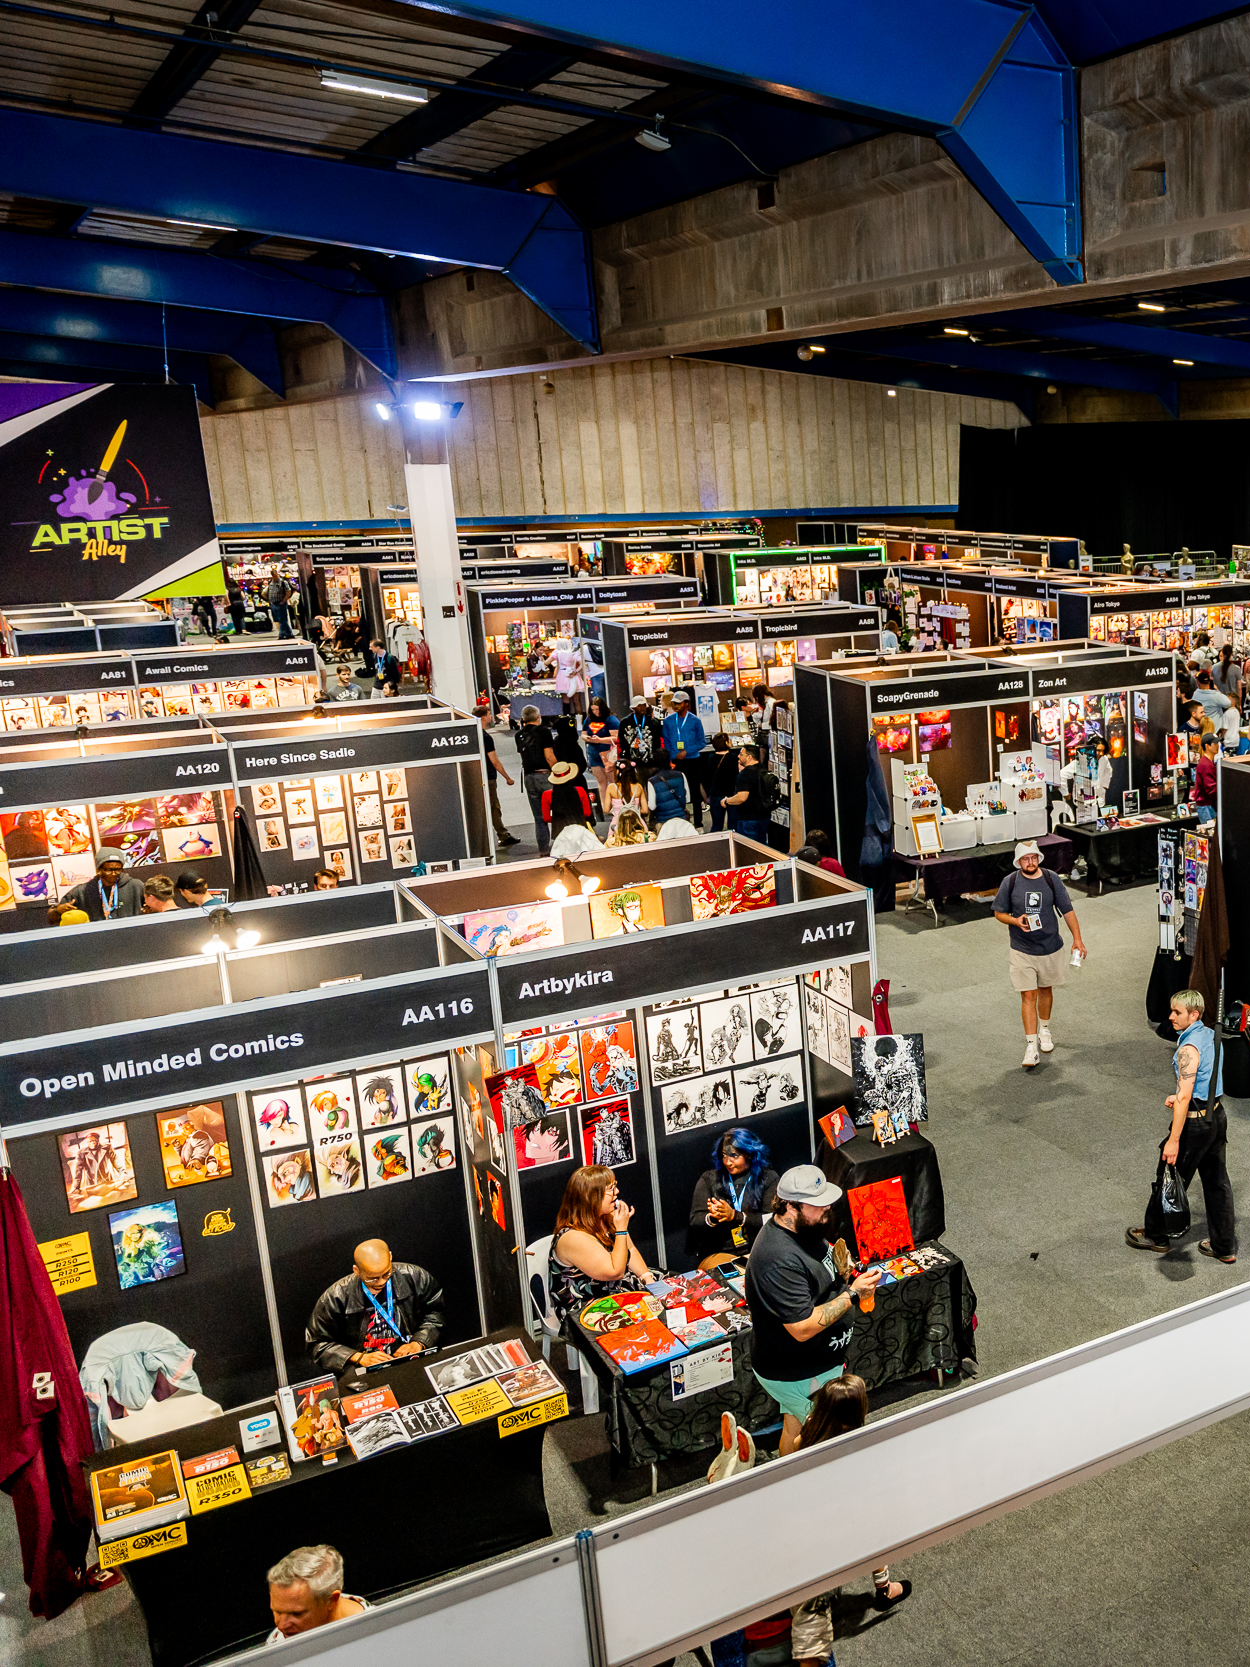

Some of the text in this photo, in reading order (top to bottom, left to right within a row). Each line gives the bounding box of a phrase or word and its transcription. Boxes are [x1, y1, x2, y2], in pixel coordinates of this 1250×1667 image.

[32, 517, 168, 547] ARTIST
[82, 539, 127, 563] Alley
[765, 624, 797, 633] Tropicbird
[631, 632, 668, 642] Tropicbird
[285, 657, 308, 666] AA81
[101, 671, 126, 680] AA81
[173, 664, 209, 674] Comics
[1145, 666, 1169, 676] AA130
[998, 680, 1023, 691] AA128
[1038, 677, 1067, 688] Zon Art
[877, 689, 939, 703] SoapyGrenade
[431, 735, 469, 748] AA123
[245, 747, 356, 769] Here Since Sadie
[176, 763, 219, 777] AA120
[801, 921, 855, 944] AA117
[518, 968, 614, 1000] Artbykira
[402, 997, 474, 1026] AA116
[19, 1032, 304, 1099] Open Minded Comics
[319, 1132, 353, 1147] R750
[55, 1258, 78, 1269] R250
[58, 1267, 79, 1278] R120
[59, 1276, 81, 1287] R100
[120, 1466, 148, 1479] COMIC
[196, 1471, 235, 1487] COMIC
[199, 1487, 242, 1506] R350
